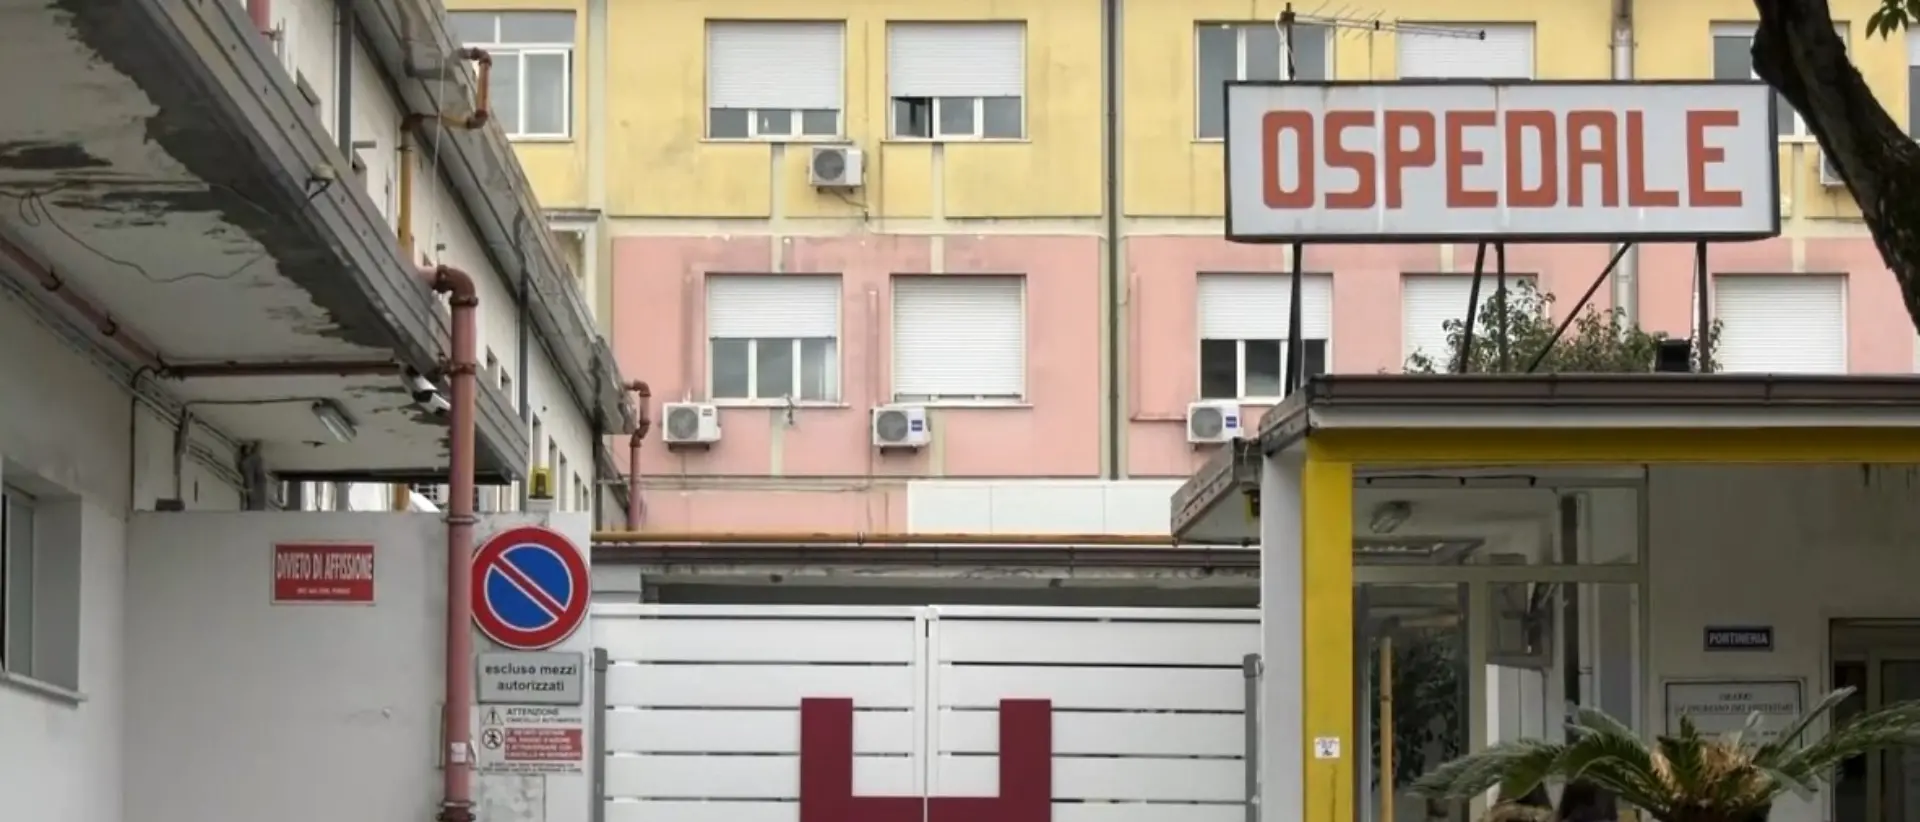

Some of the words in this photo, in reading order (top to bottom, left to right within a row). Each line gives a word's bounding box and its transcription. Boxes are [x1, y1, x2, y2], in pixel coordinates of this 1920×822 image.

[1262, 110, 1743, 209] OSPEDALE
[277, 552, 311, 580] DIVIETO
[312, 552, 323, 580] DI
[324, 552, 373, 580] AFFISSIONE
[1709, 631, 1769, 645] PORTINERIA
[485, 662, 537, 675] escluso
[540, 663, 577, 675] mezzi
[497, 680, 565, 692] autorizzati
[506, 707, 560, 716] ATTENZIONE
